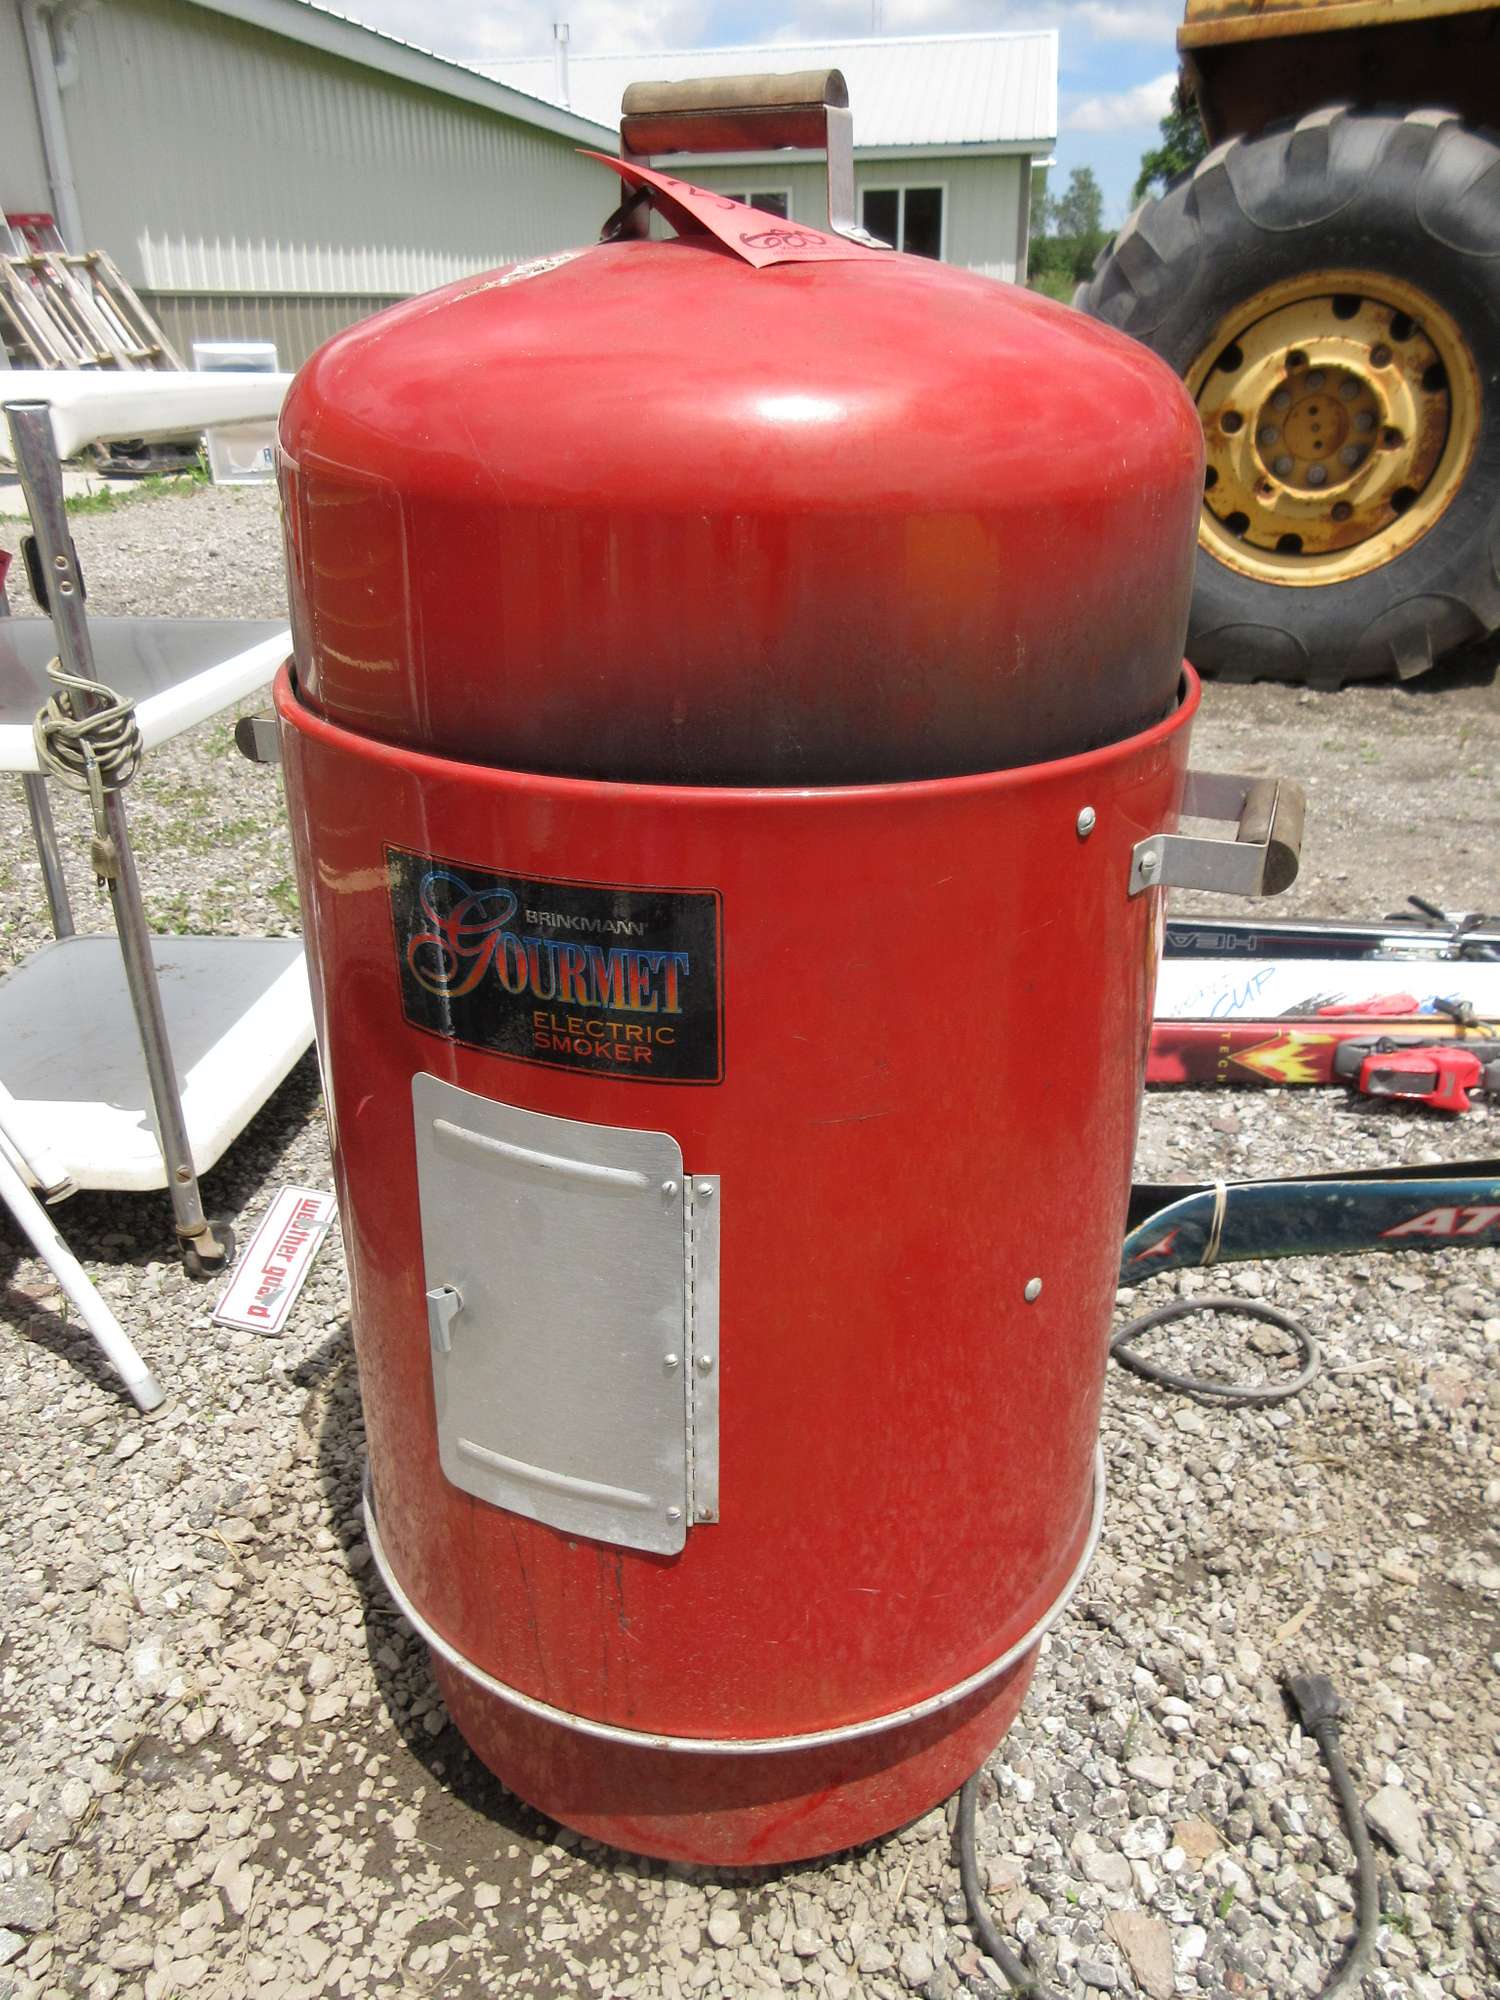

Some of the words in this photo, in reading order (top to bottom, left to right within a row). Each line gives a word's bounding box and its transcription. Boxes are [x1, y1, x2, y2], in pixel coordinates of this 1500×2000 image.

[525, 909, 645, 936] BRINKMANN
[408, 870, 690, 1014] GOURMET
[533, 1011, 675, 1044] ELECTRIC
[534, 1031, 652, 1063] SMOKER
